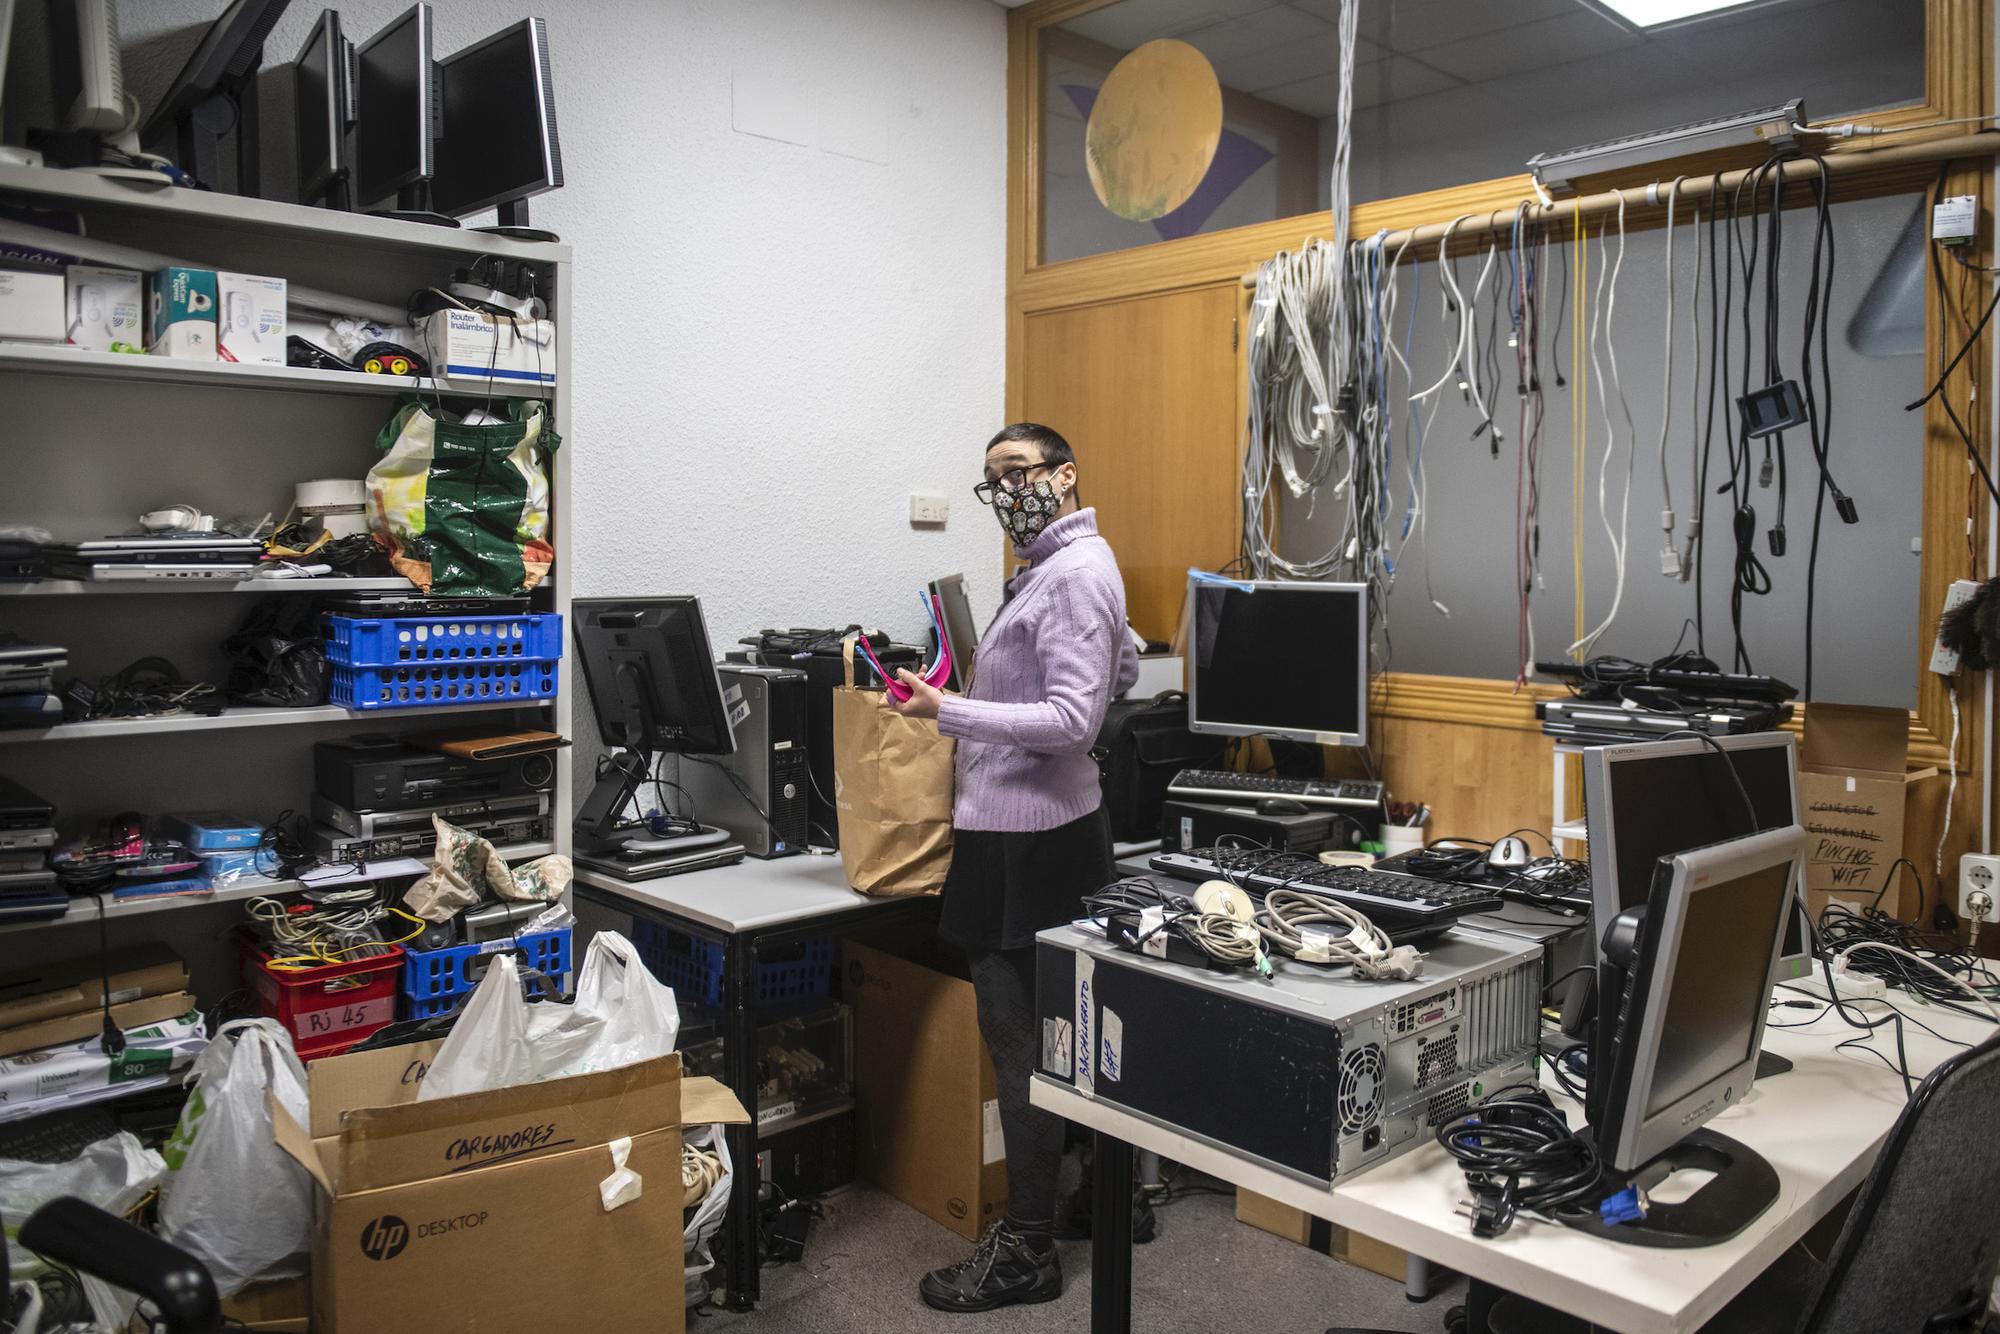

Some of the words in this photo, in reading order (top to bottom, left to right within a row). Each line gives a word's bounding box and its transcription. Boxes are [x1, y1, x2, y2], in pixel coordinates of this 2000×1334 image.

[450, 312, 476, 322] Router
[342, 1006, 369, 1026] 45
[124, 1063, 144, 1076] 80
[446, 1124, 556, 1160] CARGADORES
[366, 1217, 406, 1260] hp
[417, 1211, 489, 1238] DESKTOP
